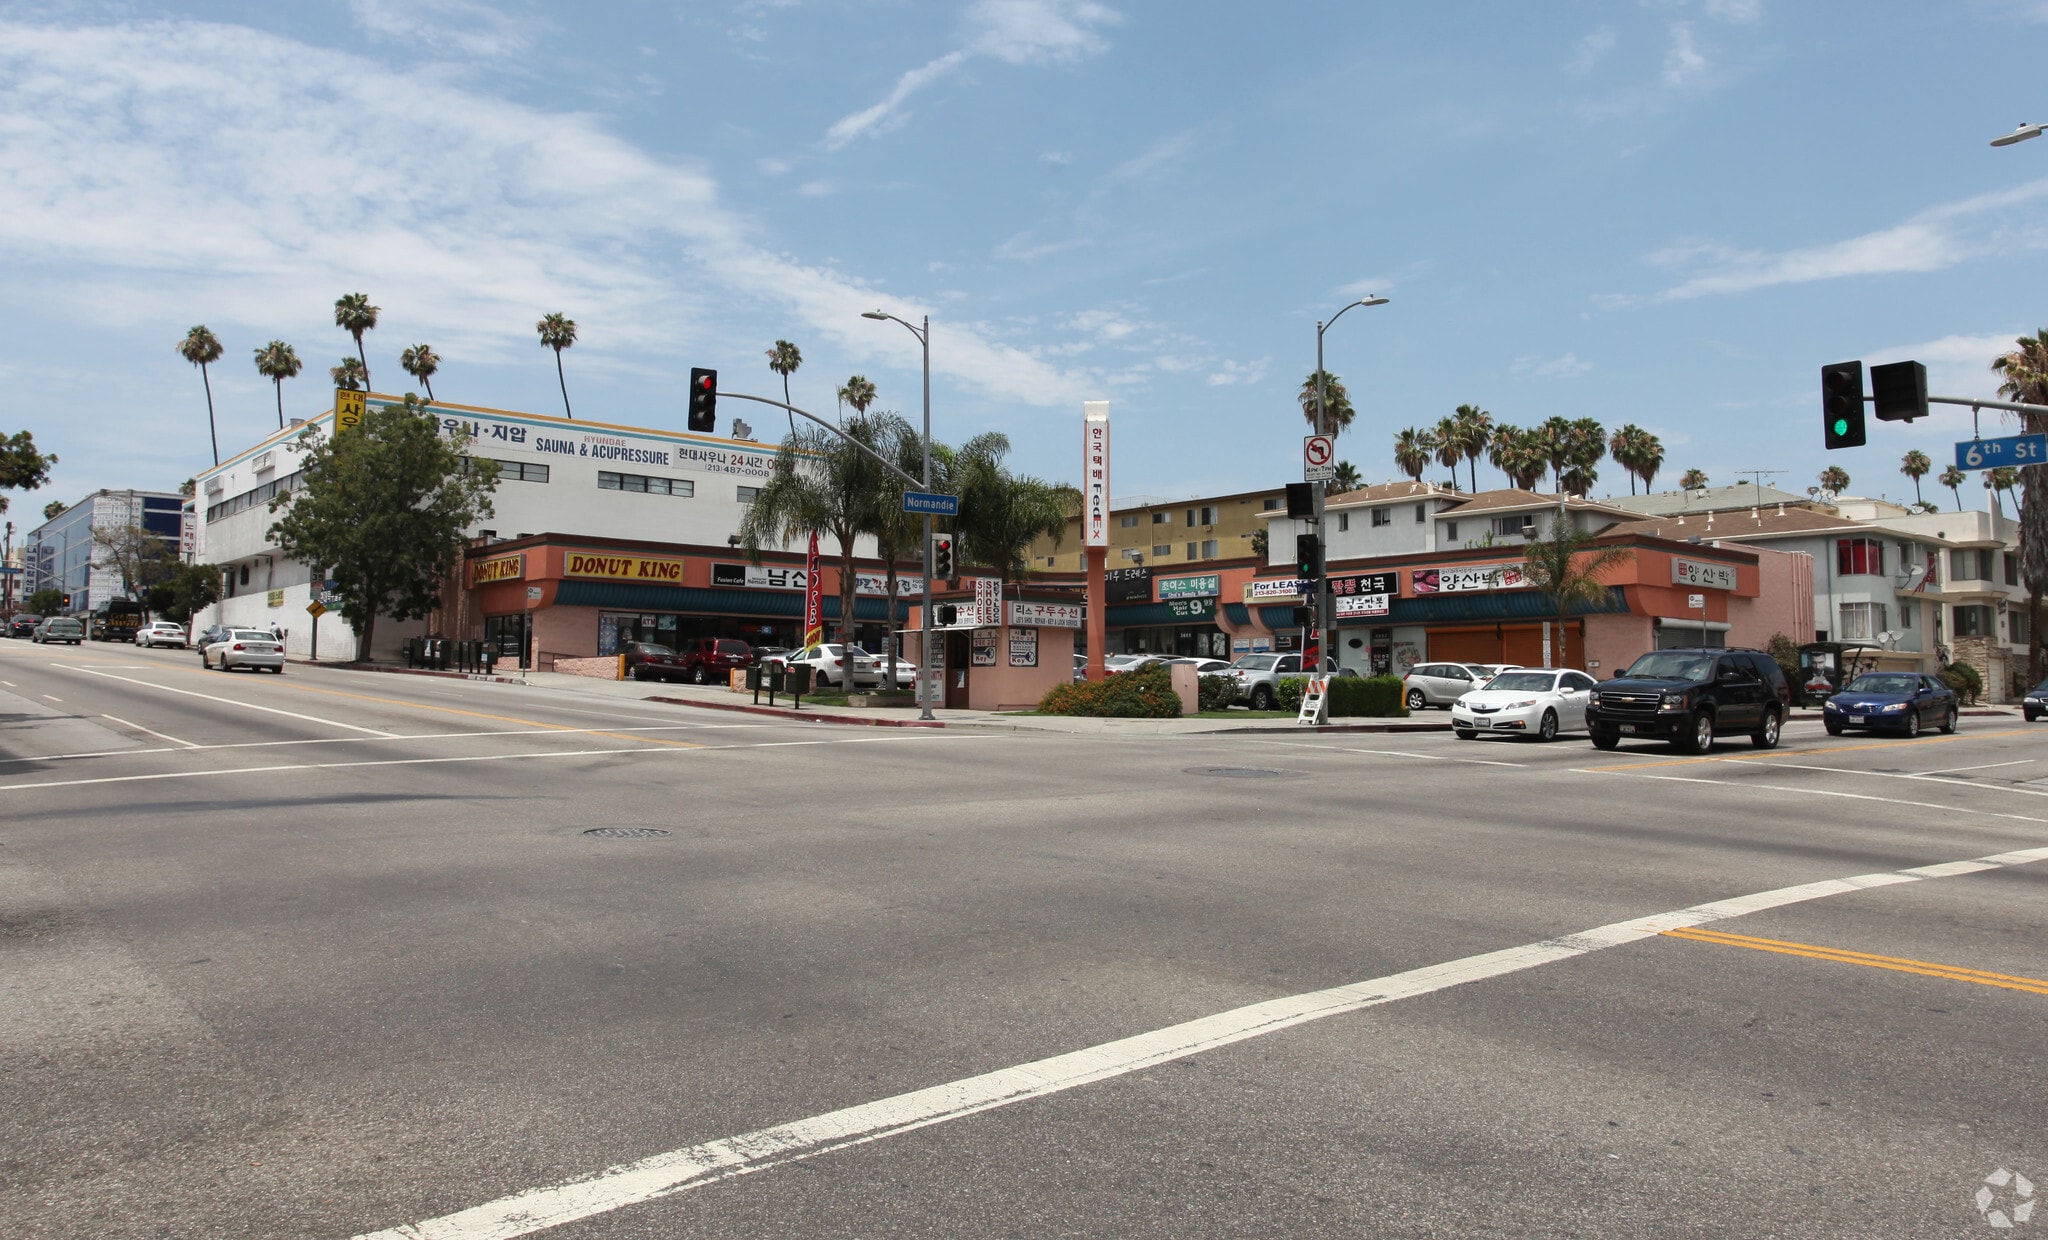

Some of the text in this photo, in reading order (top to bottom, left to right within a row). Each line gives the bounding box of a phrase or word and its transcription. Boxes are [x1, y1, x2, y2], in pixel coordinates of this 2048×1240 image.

[584, 435, 626, 447] HYUNDAE
[536, 438, 669, 466] SAUNA & ACUPRESSURE
[679, 447, 726, 464] 현대사우나
[1092, 428, 1102, 480] 한국택배
[1965, 442, 2037, 467] 6th St
[907, 496, 954, 510] Normandie
[1092, 483, 1102, 539] FedEx
[474, 558, 519, 583] DONUT KING
[571, 556, 680, 579] DONUT KING
[1688, 565, 1730, 586] 양산박
[1162, 577, 1215, 591] 초이스 미용실
[1254, 582, 1270, 590] For
[1361, 576, 1385, 592] 천국
[1015, 605, 1078, 619] 리스 구두수선
[642, 617, 657, 626] ATM
[976, 655, 987, 663] Key
